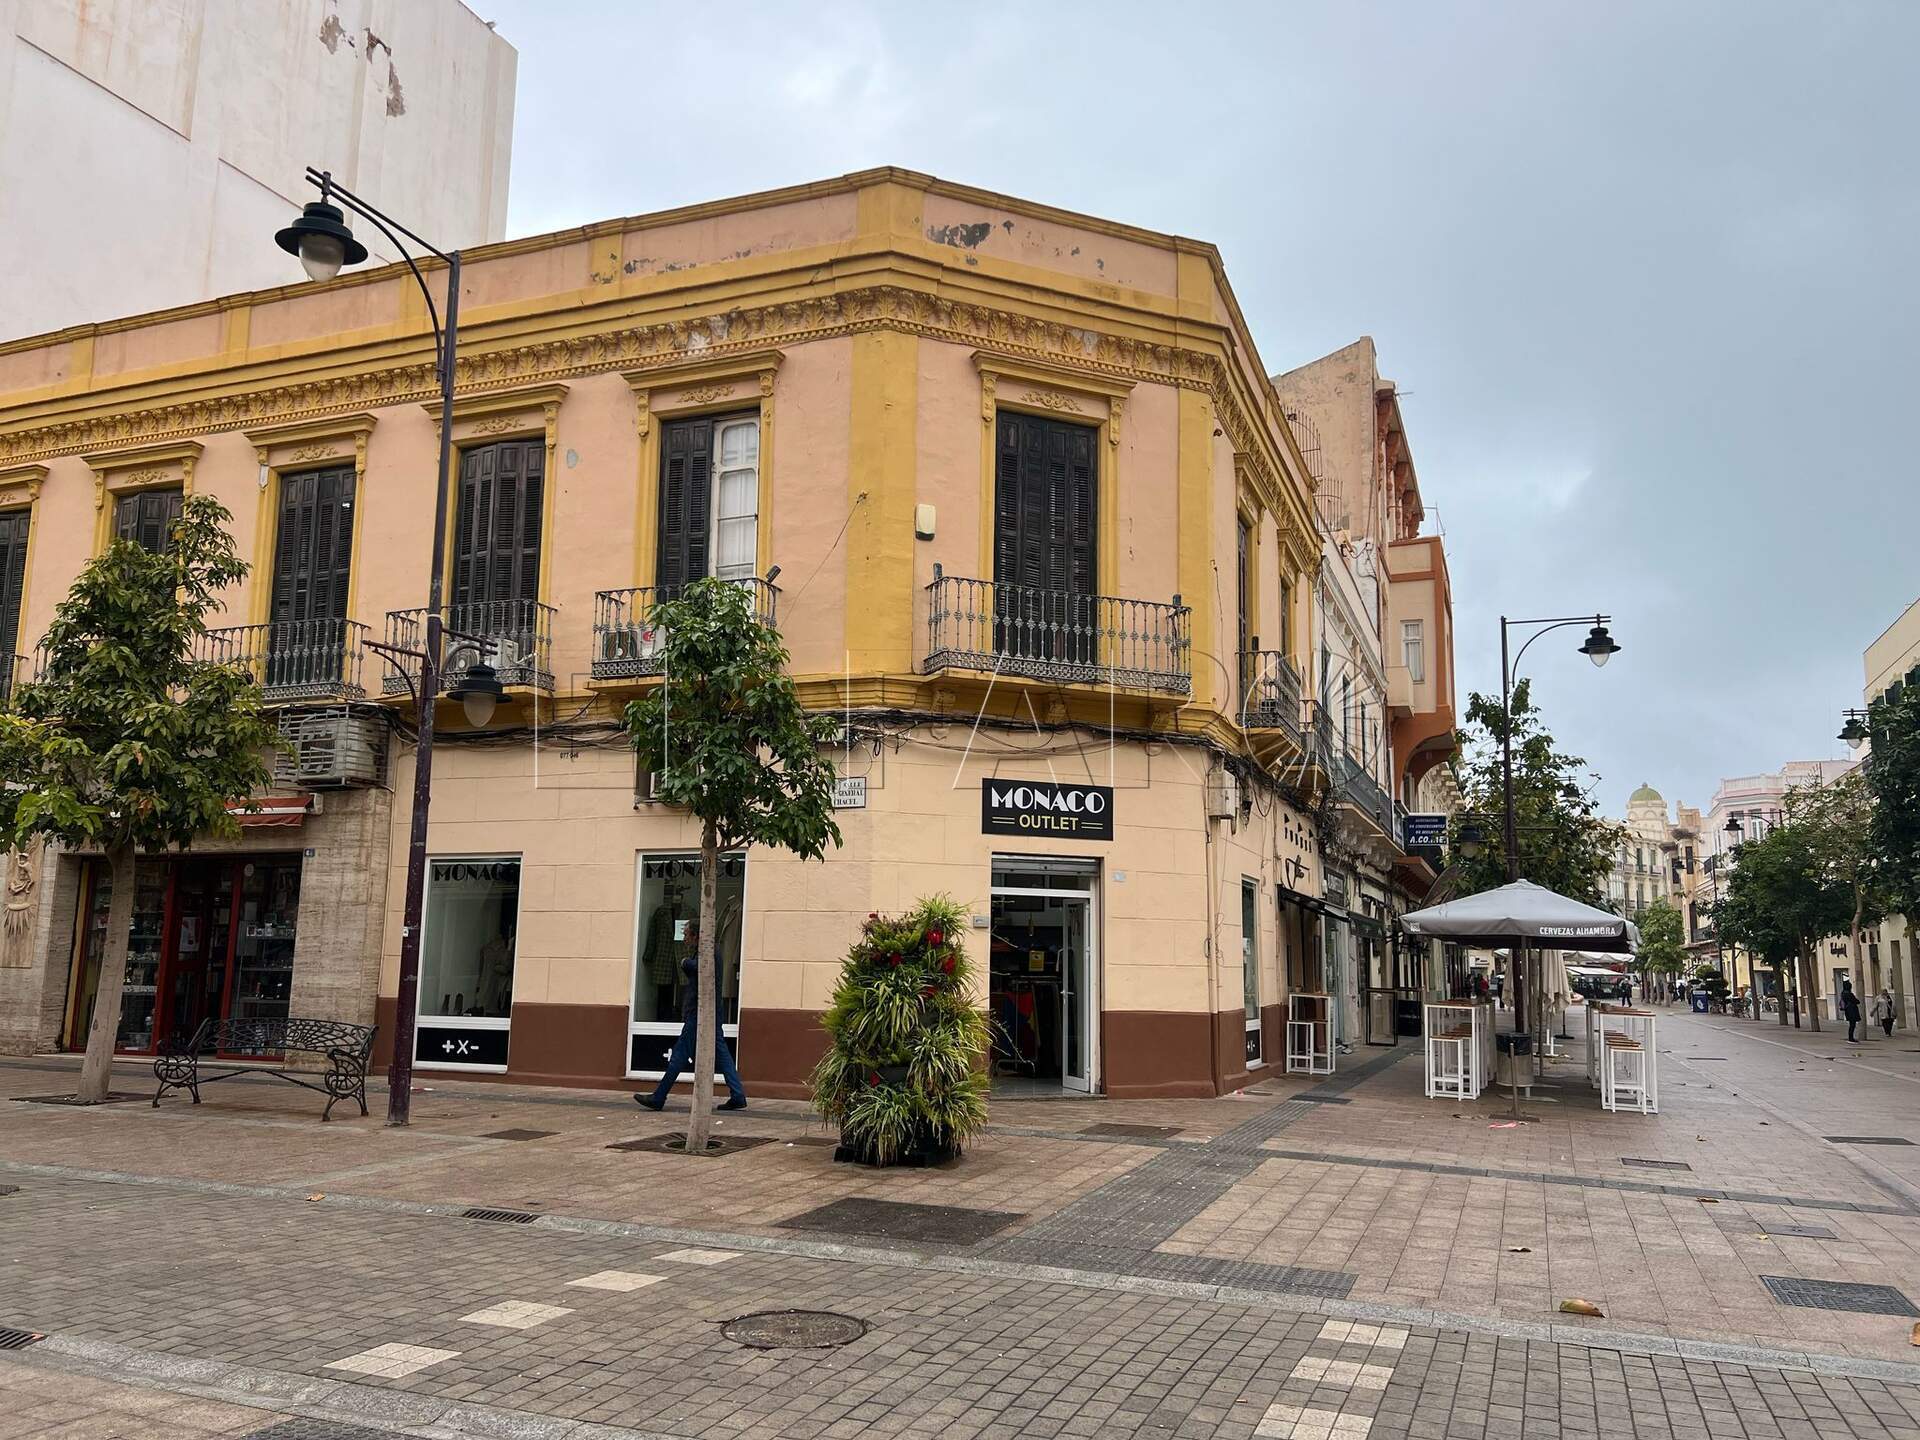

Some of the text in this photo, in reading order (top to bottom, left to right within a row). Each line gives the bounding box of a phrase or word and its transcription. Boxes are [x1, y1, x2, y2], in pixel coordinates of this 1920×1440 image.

[991, 786, 1106, 814] MONACO
[1019, 814, 1080, 831] OUTLET
[434, 863, 519, 882] MONAC
[646, 858, 741, 879] MONO
[1539, 926, 1616, 936] CERVEZAS ALHAMBRA
